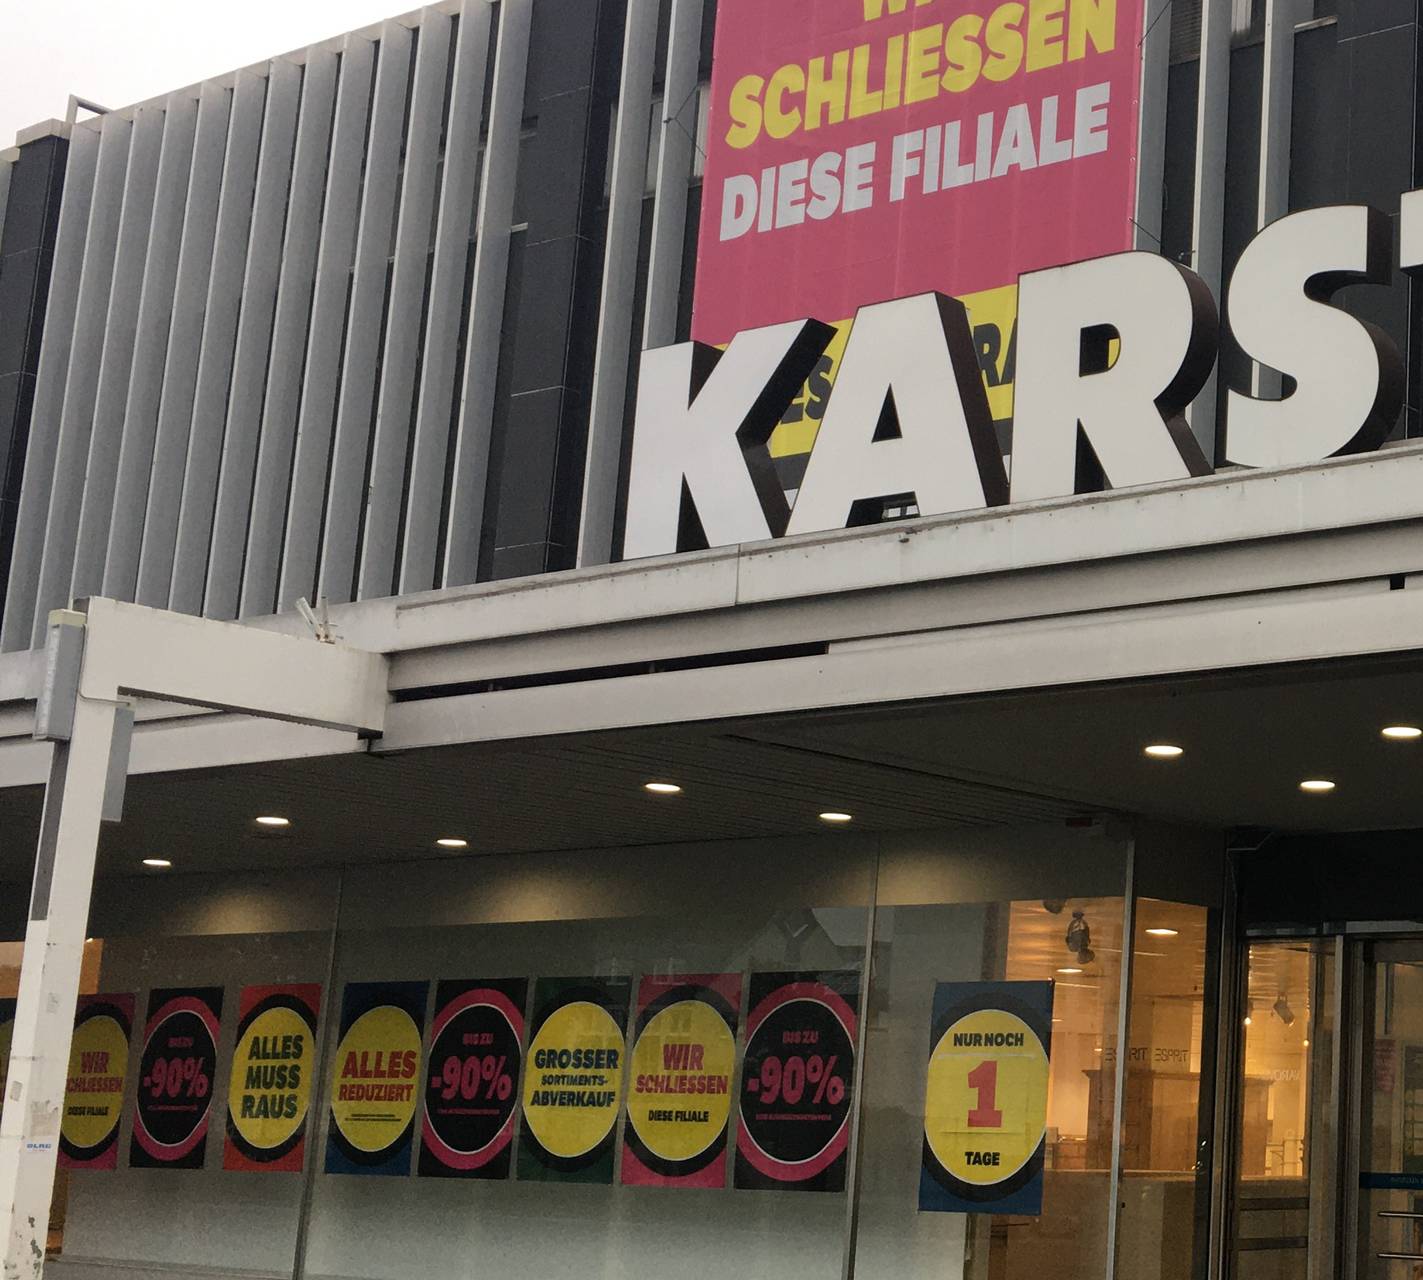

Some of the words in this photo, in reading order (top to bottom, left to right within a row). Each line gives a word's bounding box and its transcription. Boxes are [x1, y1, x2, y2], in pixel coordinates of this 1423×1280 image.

[725, 0, 1117, 149] SCHLIESSEN
[720, 141, 876, 242] DIESE
[889, 81, 1111, 202] FILIALE
[248, 1034, 305, 1061] ALLES
[953, 1032, 983, 1047] NUR
[983, 1032, 1024, 1047] NOCH
[341, 1050, 416, 1079] ALLES
[534, 1048, 619, 1069] GROSSER
[662, 1044, 705, 1071] WIR
[1105, 1048, 1148, 1062] ESRIT
[1154, 1049, 1189, 1062] ESPRIT
[66, 1077, 123, 1093] CHLIESSEN
[143, 1056, 209, 1098] -90%
[245, 1064, 302, 1090] MUSS
[431, 1055, 512, 1100] -90%
[541, 1074, 609, 1087] SORTIMENTS-
[634, 1074, 729, 1095] SCHLIESSEN
[747, 1054, 846, 1105] -90%
[338, 1083, 415, 1102] REDUZIERT
[530, 1090, 616, 1108] ABVERKAUF
[966, 1060, 1003, 1129] 1
[241, 1094, 298, 1119] RAUS
[648, 1109, 673, 1122] DIESE
[674, 1110, 710, 1123] FILIALE
[964, 1151, 1001, 1167] TAGE
